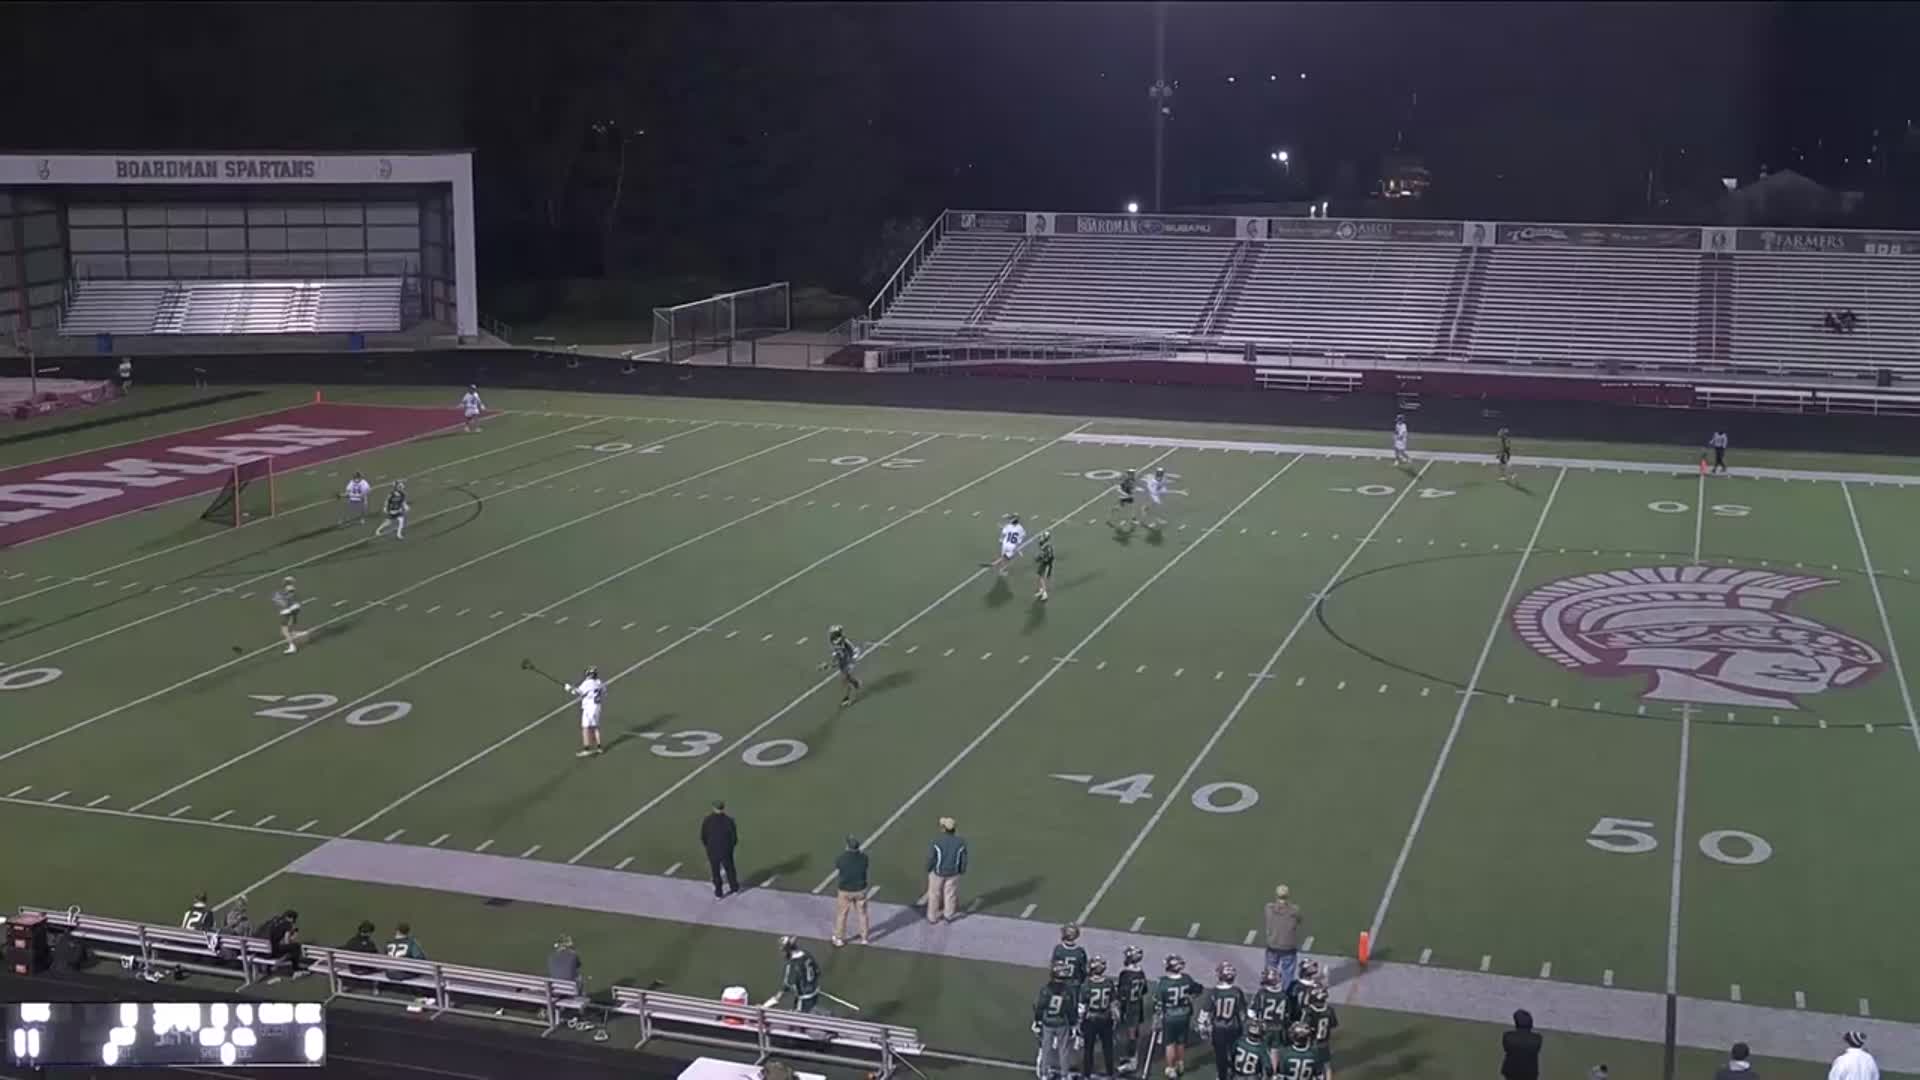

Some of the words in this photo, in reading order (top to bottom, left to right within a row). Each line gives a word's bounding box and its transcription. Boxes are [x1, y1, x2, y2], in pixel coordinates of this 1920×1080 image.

[116, 160, 218, 178] BOARDMAN
[225, 160, 315, 178] SPARTANS
[1077, 216, 1138, 232] BOARDMAN
[253, 693, 412, 725] 20
[650, 730, 809, 767] 30
[1087, 773, 1260, 813] 40
[1585, 817, 1772, 864] 50
[1048, 995, 1063, 1015] 9
[1216, 997, 1235, 1018] 10
[1263, 999, 1286, 1020] 24
[1234, 1047, 1259, 1074] 28
[1287, 1058, 1315, 1080] 36
